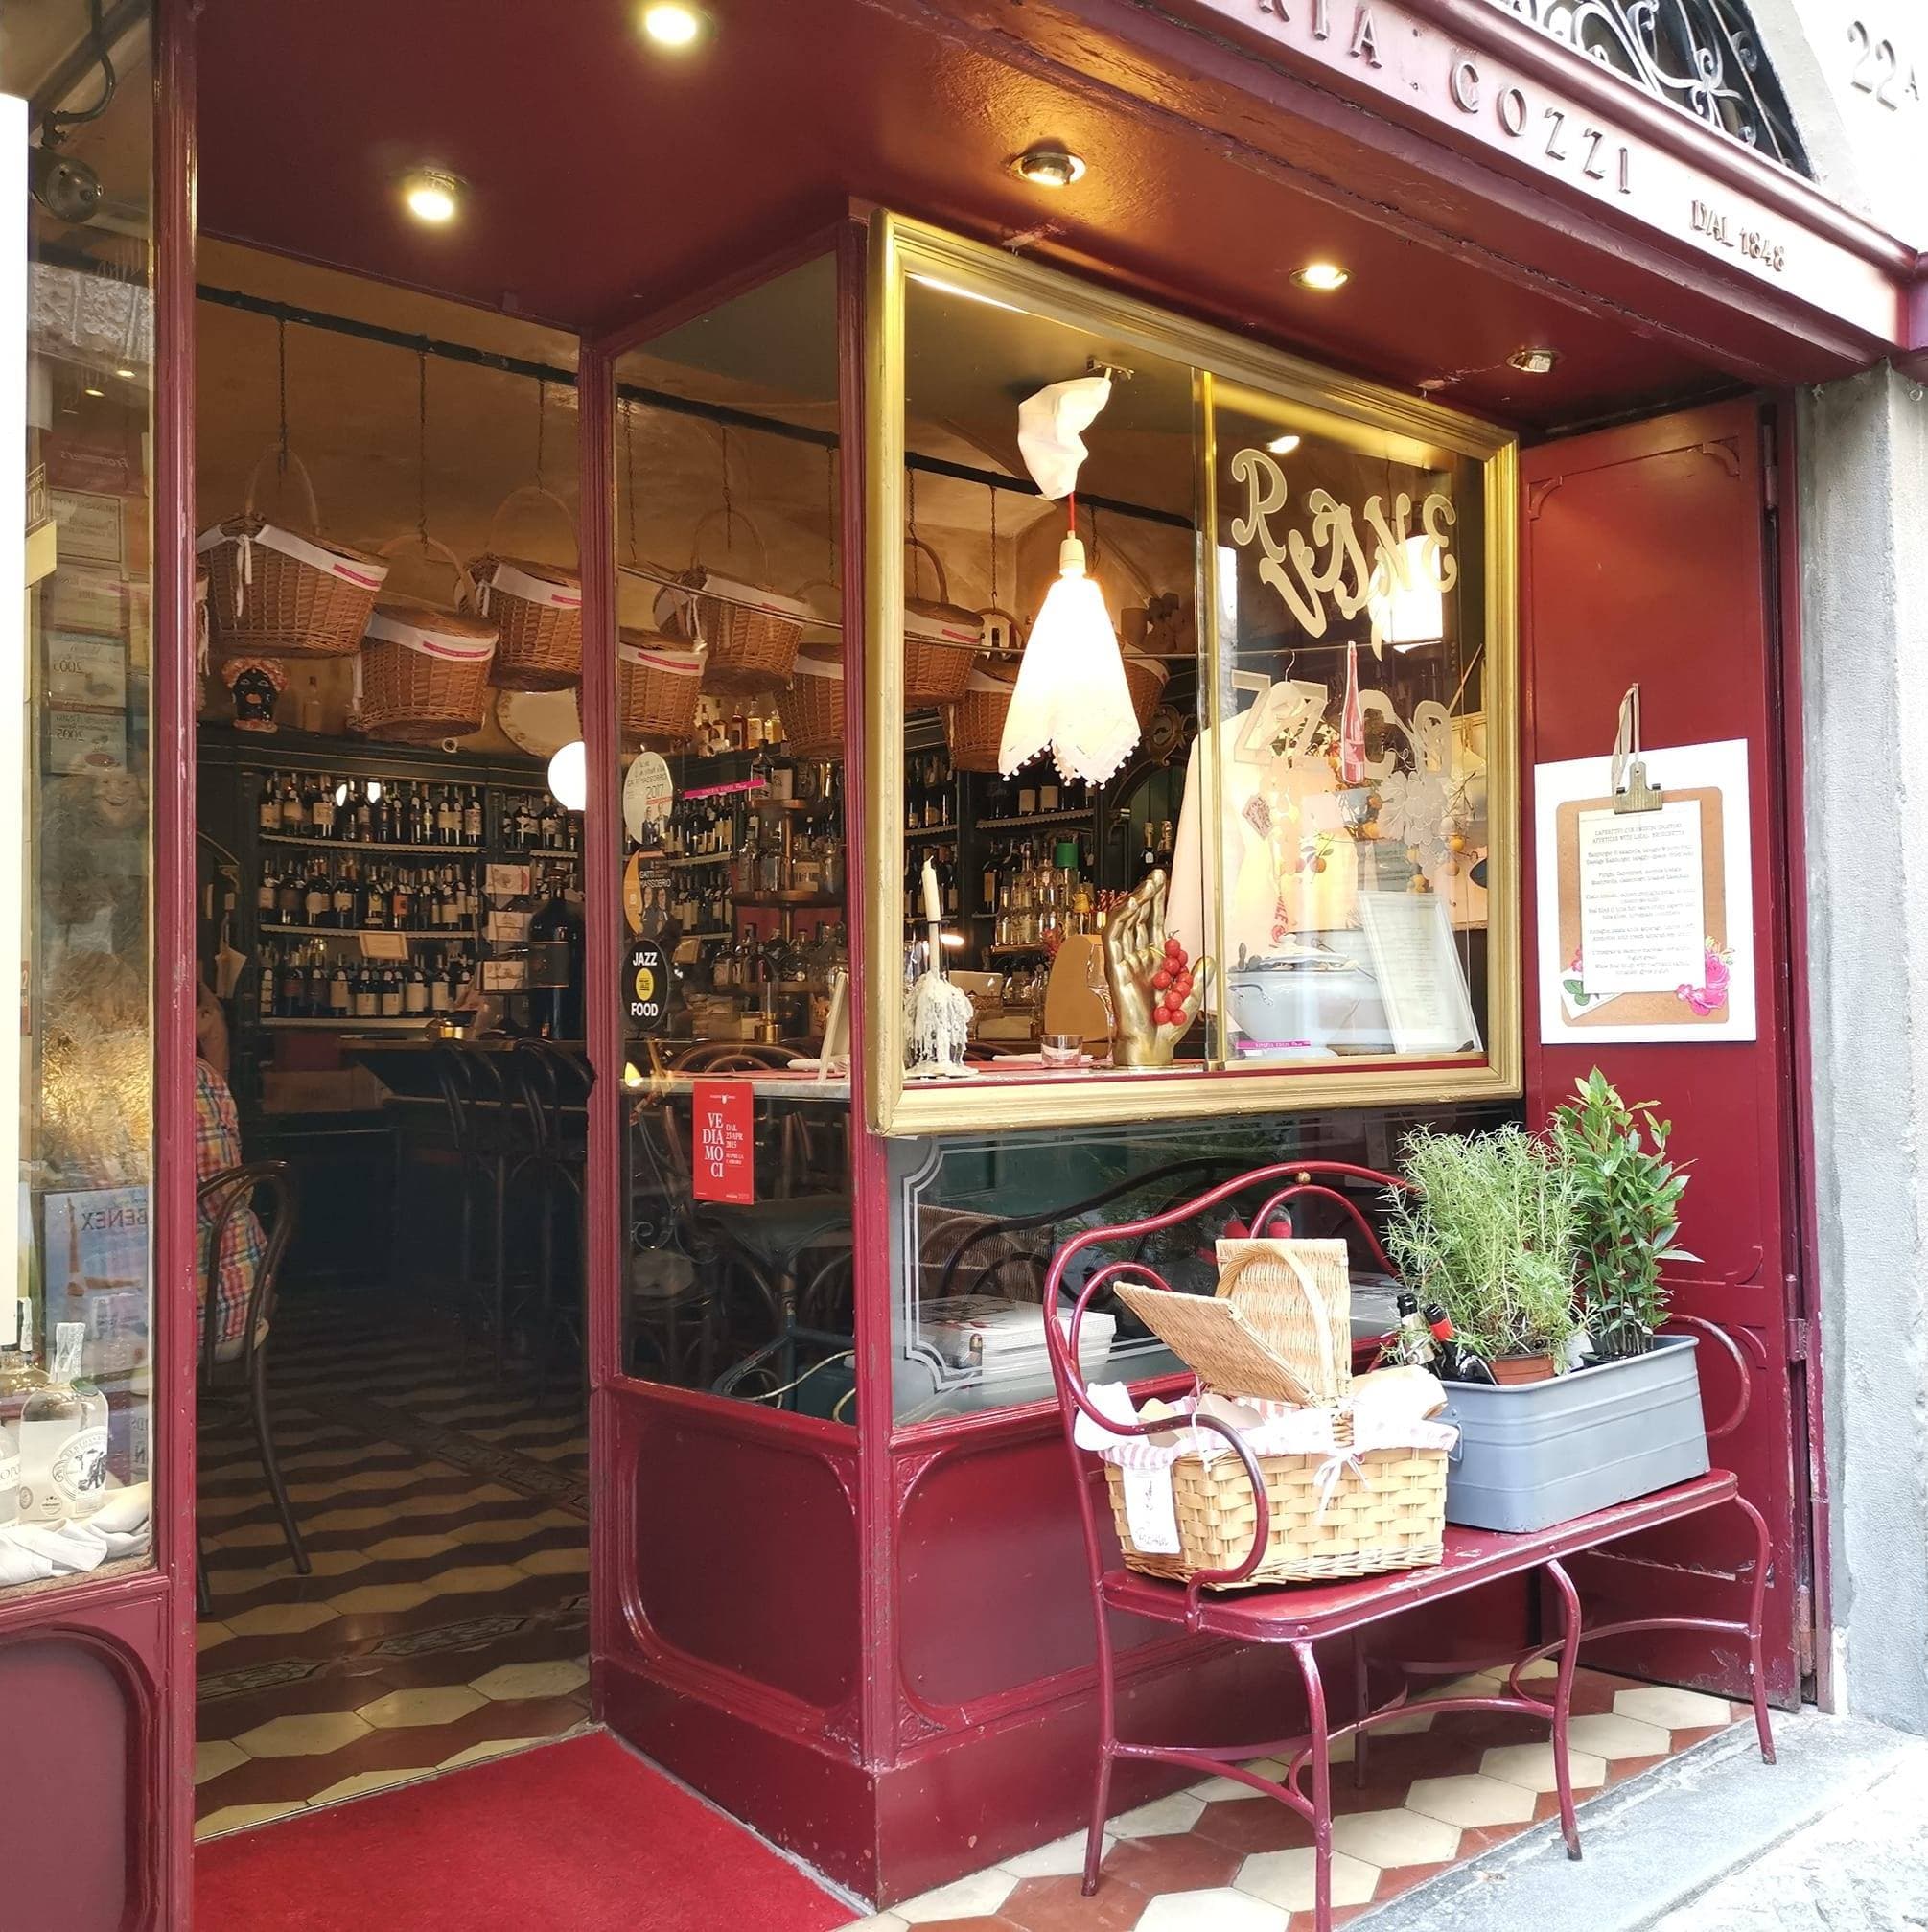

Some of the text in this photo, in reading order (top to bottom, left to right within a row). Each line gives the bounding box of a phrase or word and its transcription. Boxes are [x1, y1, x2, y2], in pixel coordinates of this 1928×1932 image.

[1450, 61, 1631, 194] COZZI
[1690, 199, 1784, 272] DAL 1848
[633, 952, 658, 966] JAZZ
[631, 1003, 659, 1016] FOOD
[708, 1112, 723, 1129] VE
[703, 1129, 724, 1145] DIA
[705, 1145, 724, 1161] MO
[711, 1163, 724, 1177] CI
